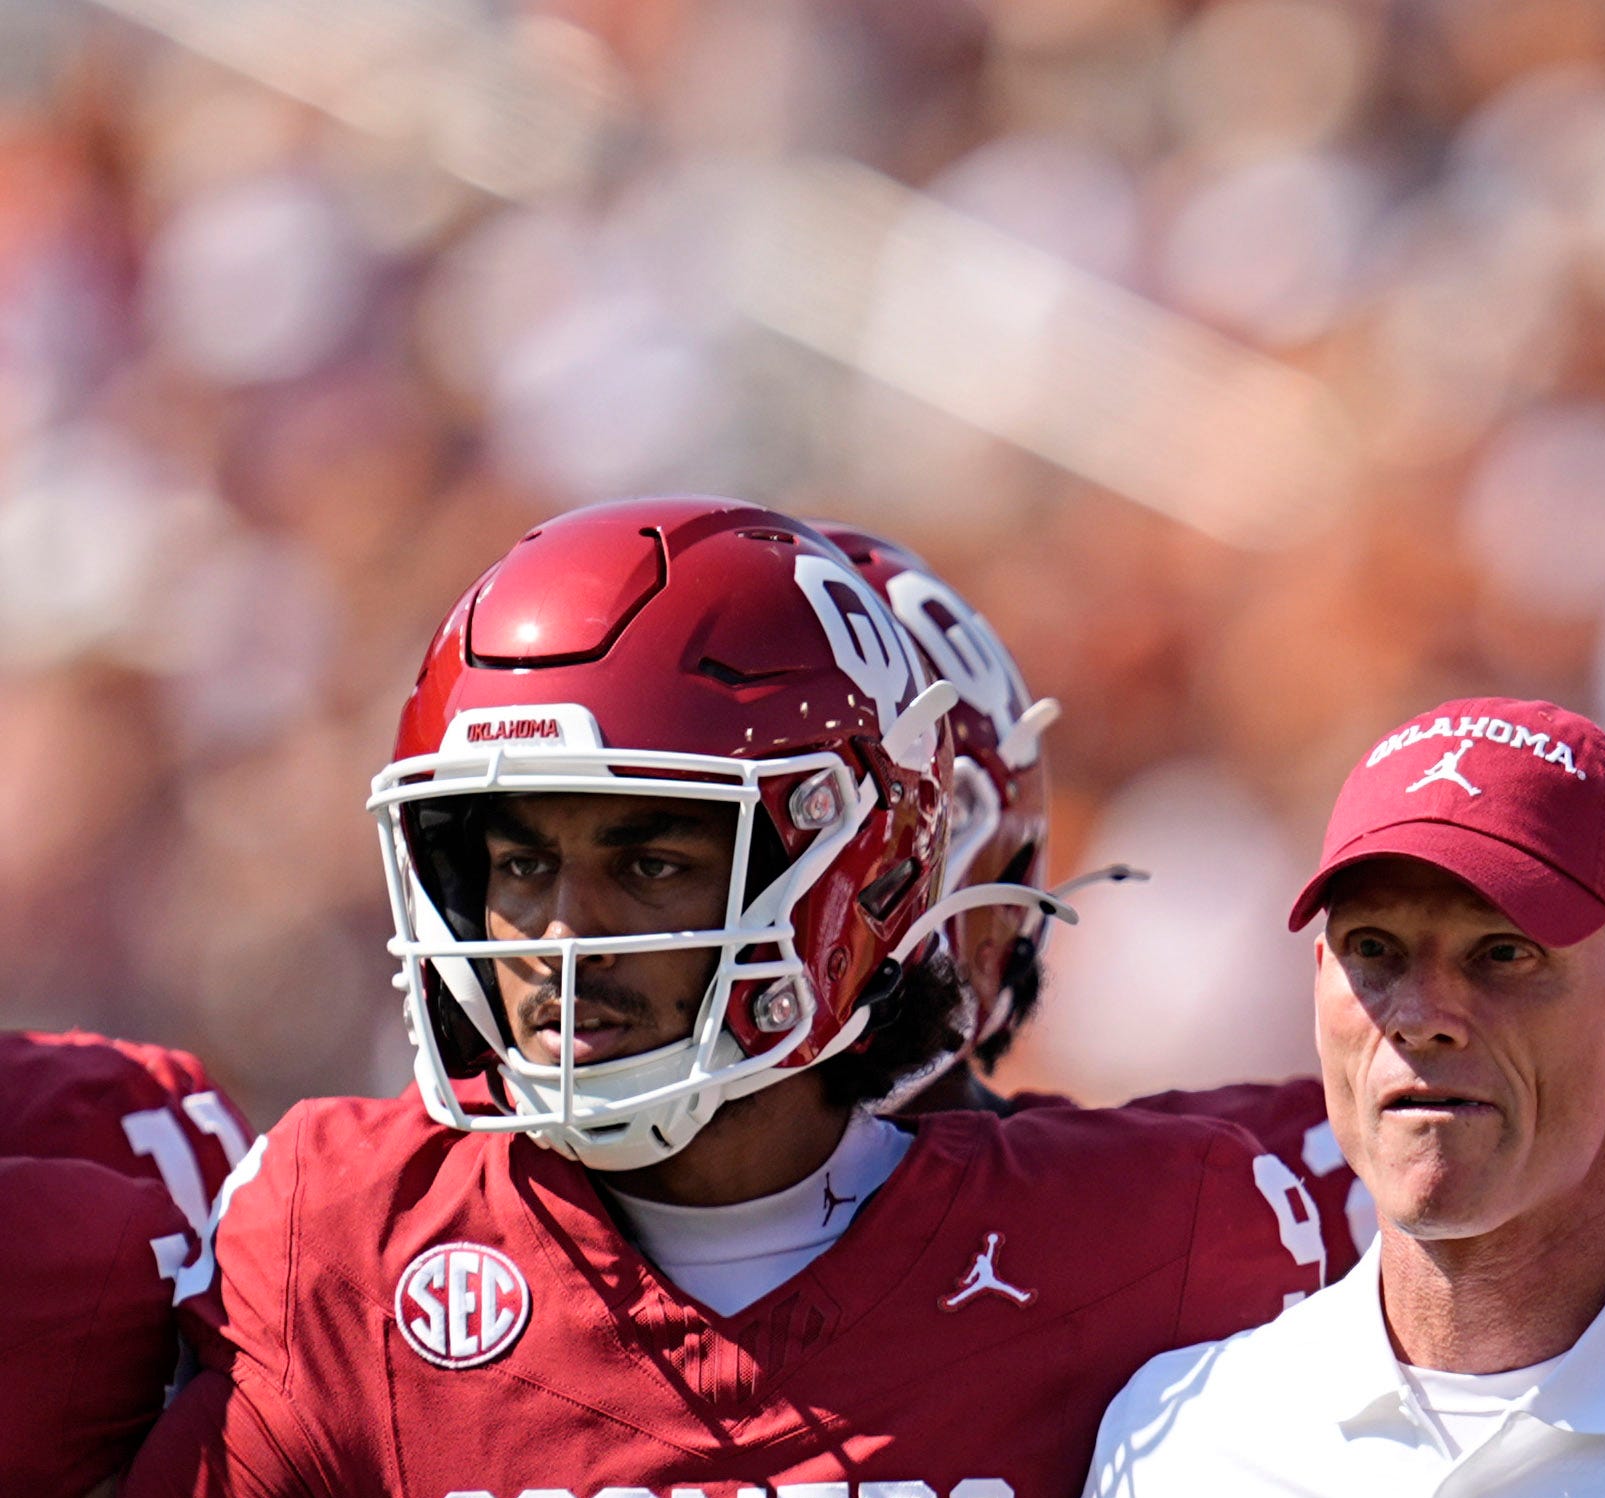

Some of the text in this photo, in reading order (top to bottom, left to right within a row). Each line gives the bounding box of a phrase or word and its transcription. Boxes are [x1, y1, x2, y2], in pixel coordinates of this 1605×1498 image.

[467, 719, 559, 743] OKLAHOMA
[1366, 716, 1578, 775] OKLAHOMA
[407, 1250, 515, 1357] SEC
